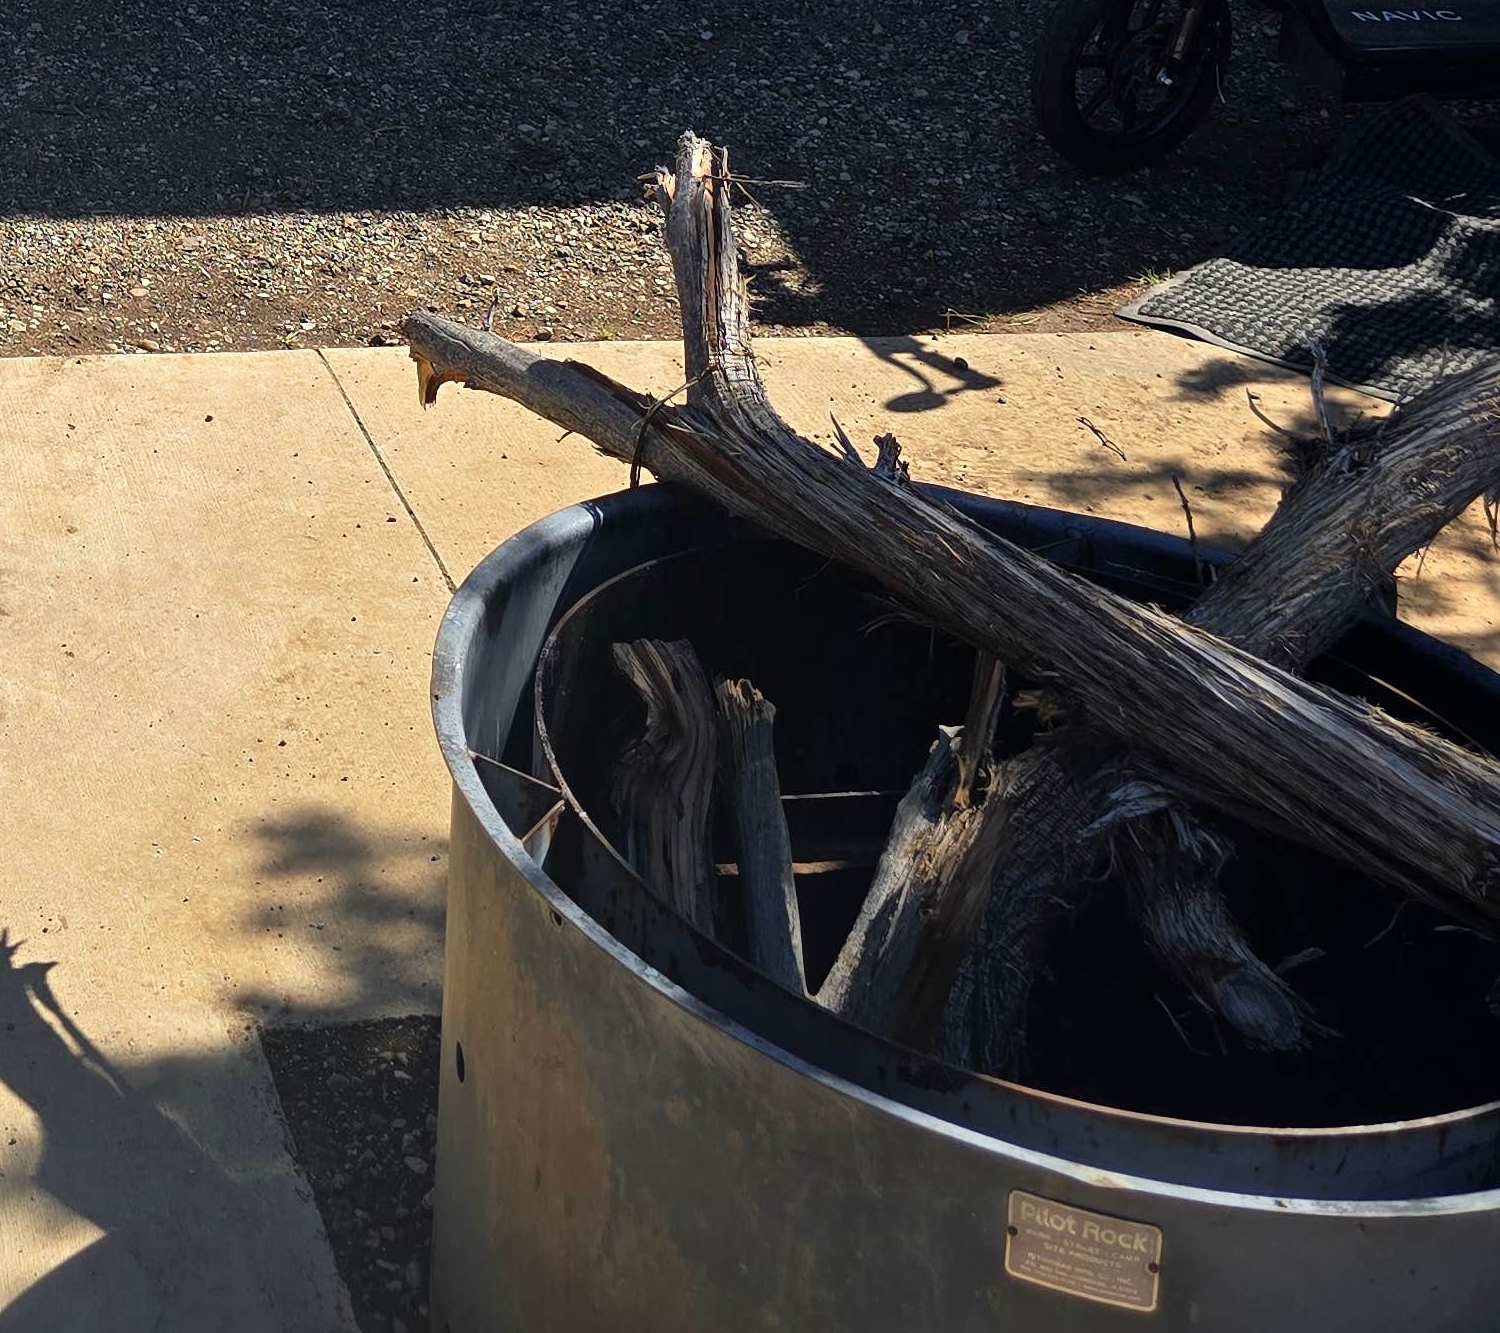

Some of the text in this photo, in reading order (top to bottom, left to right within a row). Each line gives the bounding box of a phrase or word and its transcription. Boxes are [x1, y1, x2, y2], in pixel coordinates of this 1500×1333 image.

[1351, 9, 1463, 22] NAVIC
[1020, 1201, 1149, 1253] Pilot Rock
